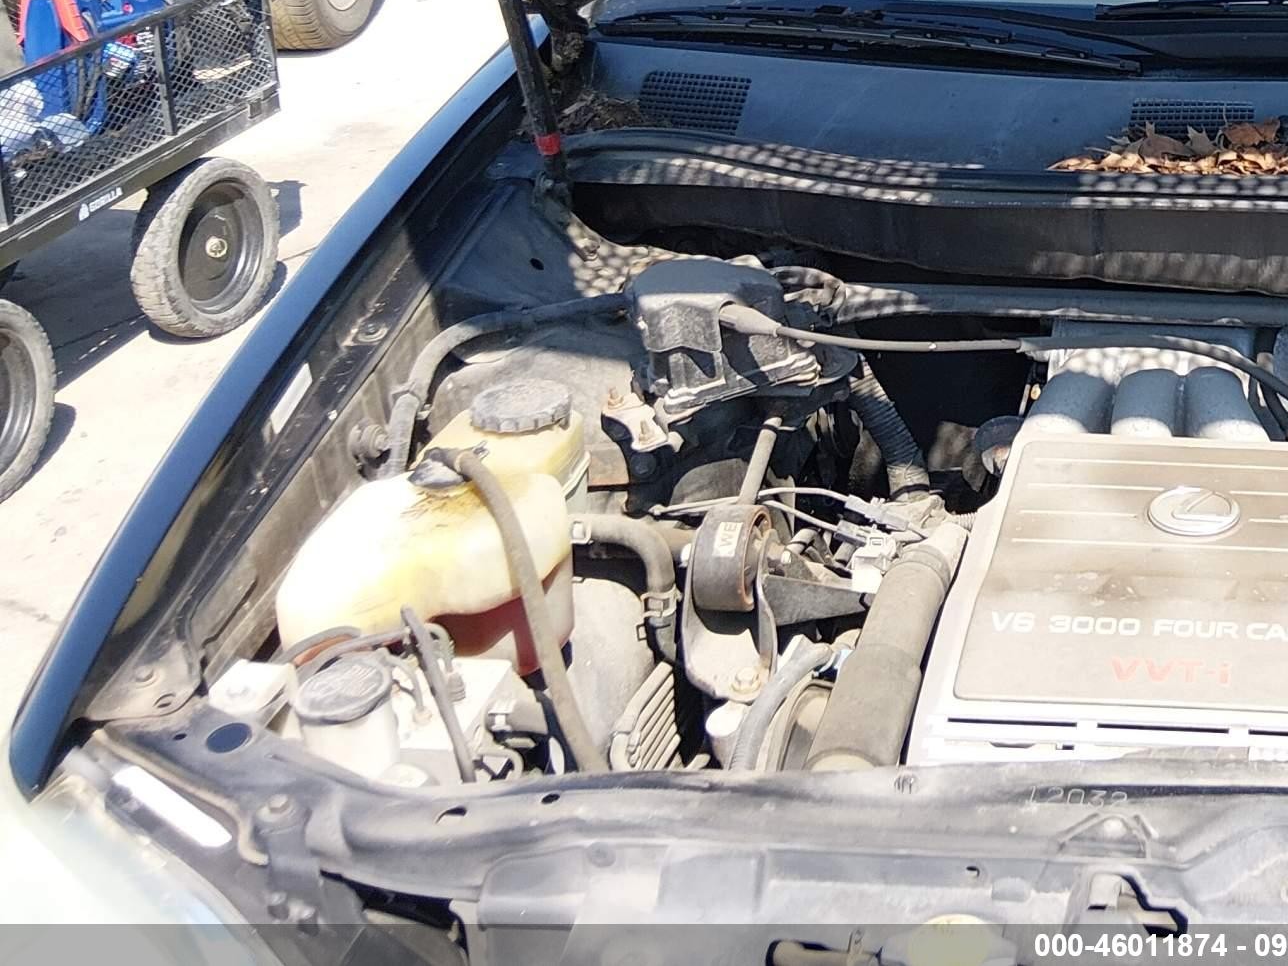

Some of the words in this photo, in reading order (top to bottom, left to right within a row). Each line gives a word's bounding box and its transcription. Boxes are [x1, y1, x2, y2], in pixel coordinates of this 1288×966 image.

[991, 611, 1035, 633] V6
[1048, 616, 1141, 637] 3000
[1152, 619, 1239, 640] FOUR
[1109, 658, 1233, 686] VVT-i
